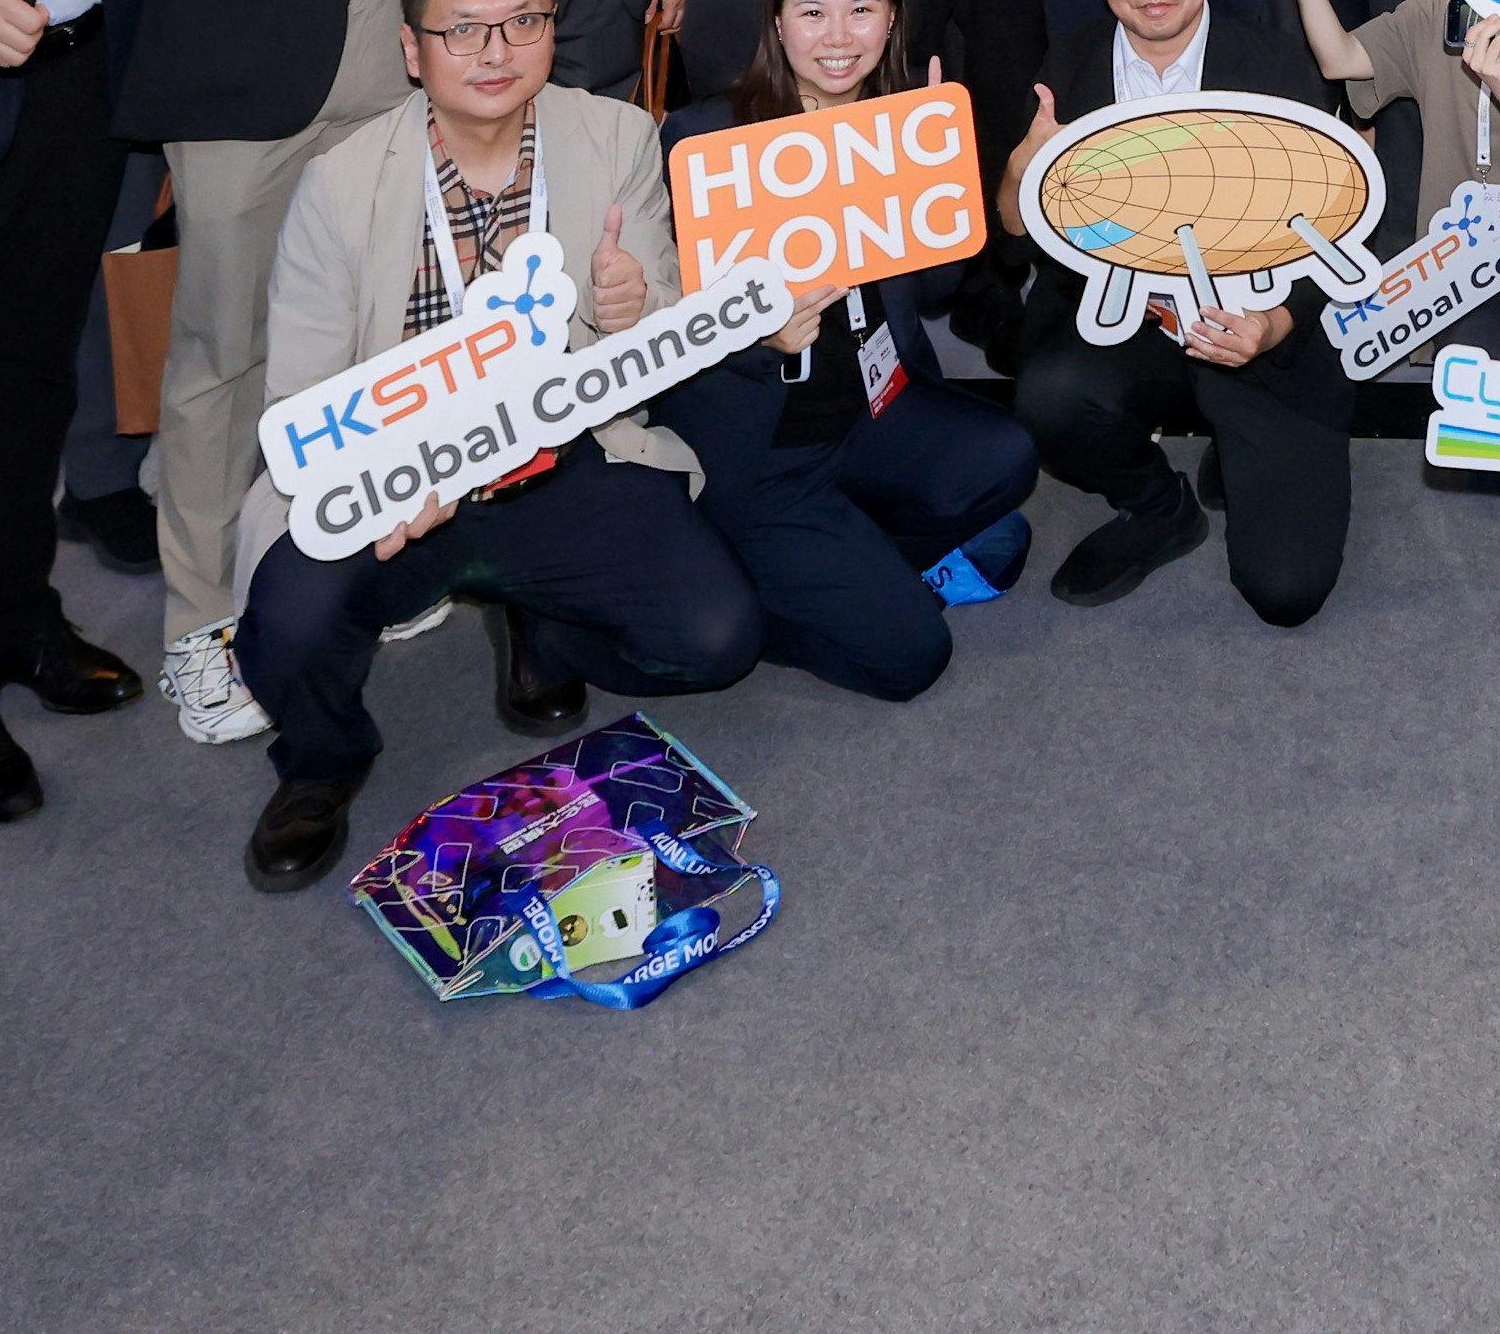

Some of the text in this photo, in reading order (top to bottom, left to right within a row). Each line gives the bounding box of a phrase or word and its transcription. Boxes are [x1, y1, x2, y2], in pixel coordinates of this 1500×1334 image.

[687, 99, 963, 219] HONG
[696, 182, 973, 285] KONG
[1334, 235, 1461, 337] HKSTP
[1353, 280, 1464, 370] Global
[285, 318, 518, 469] HKSTP
[315, 278, 774, 535] Global Connect
[521, 895, 563, 964] MODEL
[623, 948, 681, 985] ARGE
